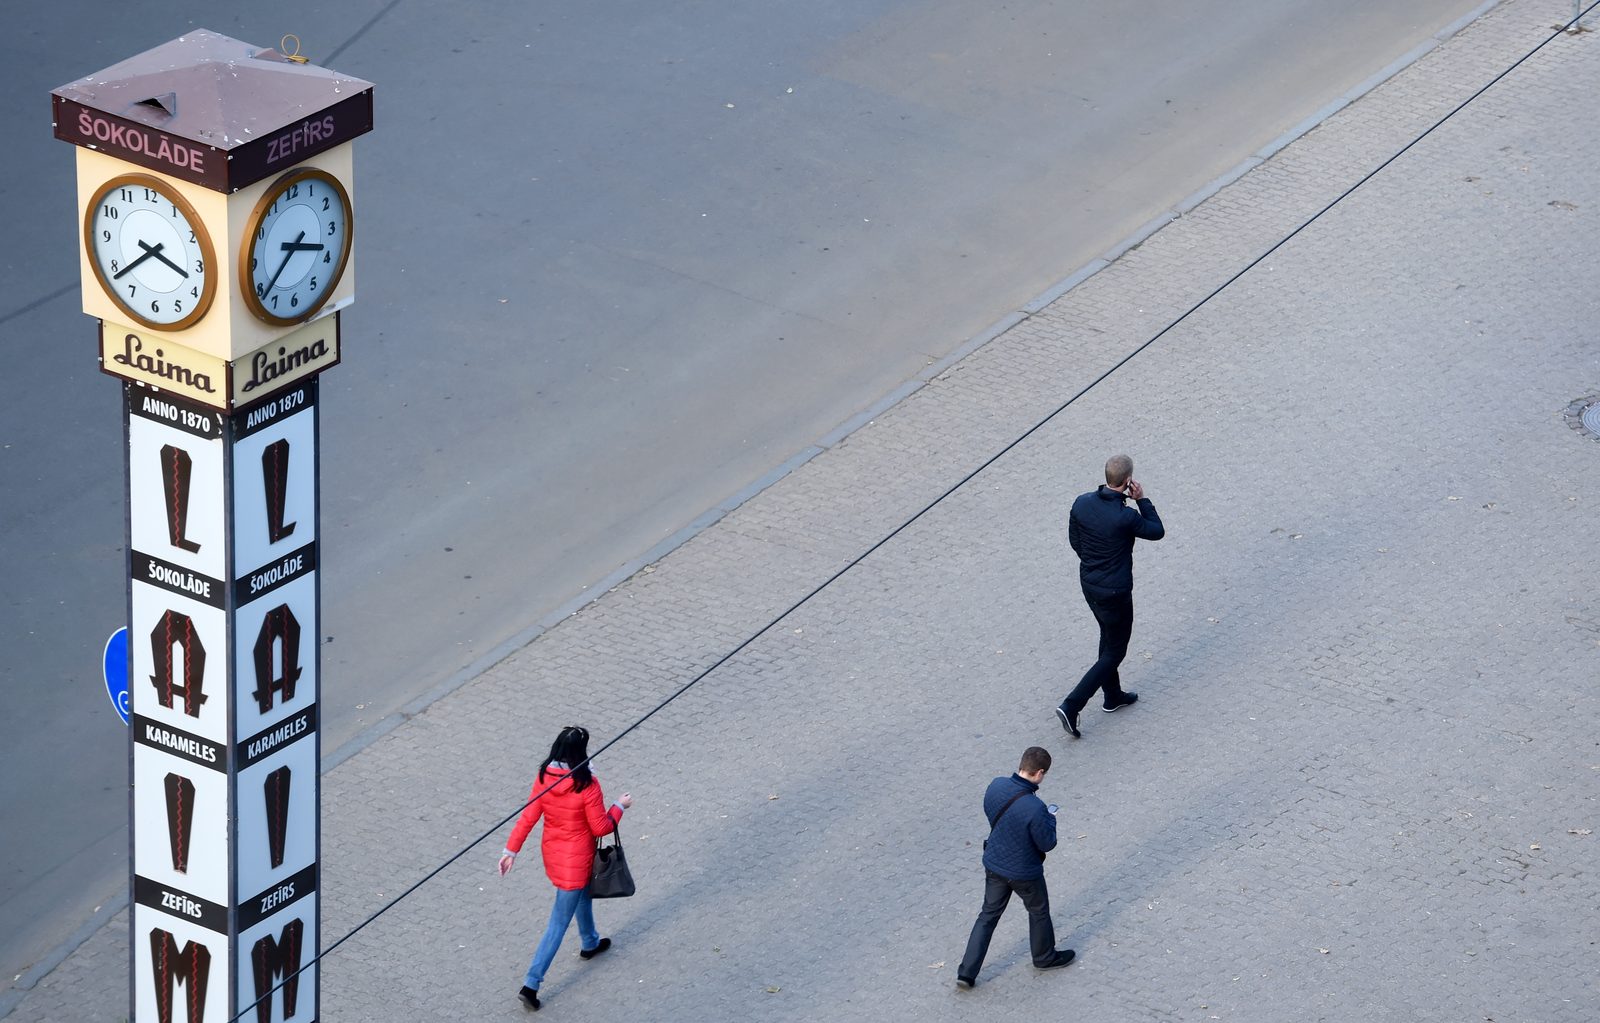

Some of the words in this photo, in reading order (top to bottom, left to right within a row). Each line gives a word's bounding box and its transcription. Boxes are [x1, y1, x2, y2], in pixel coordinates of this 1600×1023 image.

[78, 109, 205, 174] ŠOKOLĀDE
[121, 188, 133, 203] 11
[144, 188, 158, 204] 12
[285, 184, 299, 201] 12
[309, 184, 314, 197] 1
[172, 205, 177, 218] 1
[322, 197, 330, 212] 2
[103, 205, 119, 220] 10
[327, 221, 336, 236] 3
[103, 230, 112, 243] 9
[189, 230, 197, 244] 2
[323, 250, 331, 264] 4
[111, 259, 119, 272] 8
[195, 259, 204, 273] 3
[128, 284, 137, 298] 7
[257, 282, 264, 297] 8
[310, 276, 318, 291] 5
[190, 286, 199, 298] 4
[151, 300, 160, 313] 6
[174, 300, 182, 313] 5
[271, 295, 279, 310] 7
[290, 293, 299, 308] 6
[113, 333, 216, 394] Laima
[242, 338, 330, 392] Laima
[142, 396, 178, 421] ANNO
[180, 409, 211, 433] 1870
[246, 402, 277, 430] ANNO
[278, 388, 304, 413] 1870
[160, 443, 202, 555] L
[262, 438, 297, 545] L
[148, 560, 211, 598] ŠOKOLĀDE
[250, 555, 303, 594] ŠOKOLĀDE
[149, 608, 209, 719] A
[252, 602, 303, 715] A
[145, 724, 216, 763] KARAMELES
[248, 715, 307, 760] KARAMELES
[161, 891, 202, 919] ZEFĪRS
[261, 882, 295, 913] ZEFĪRS
